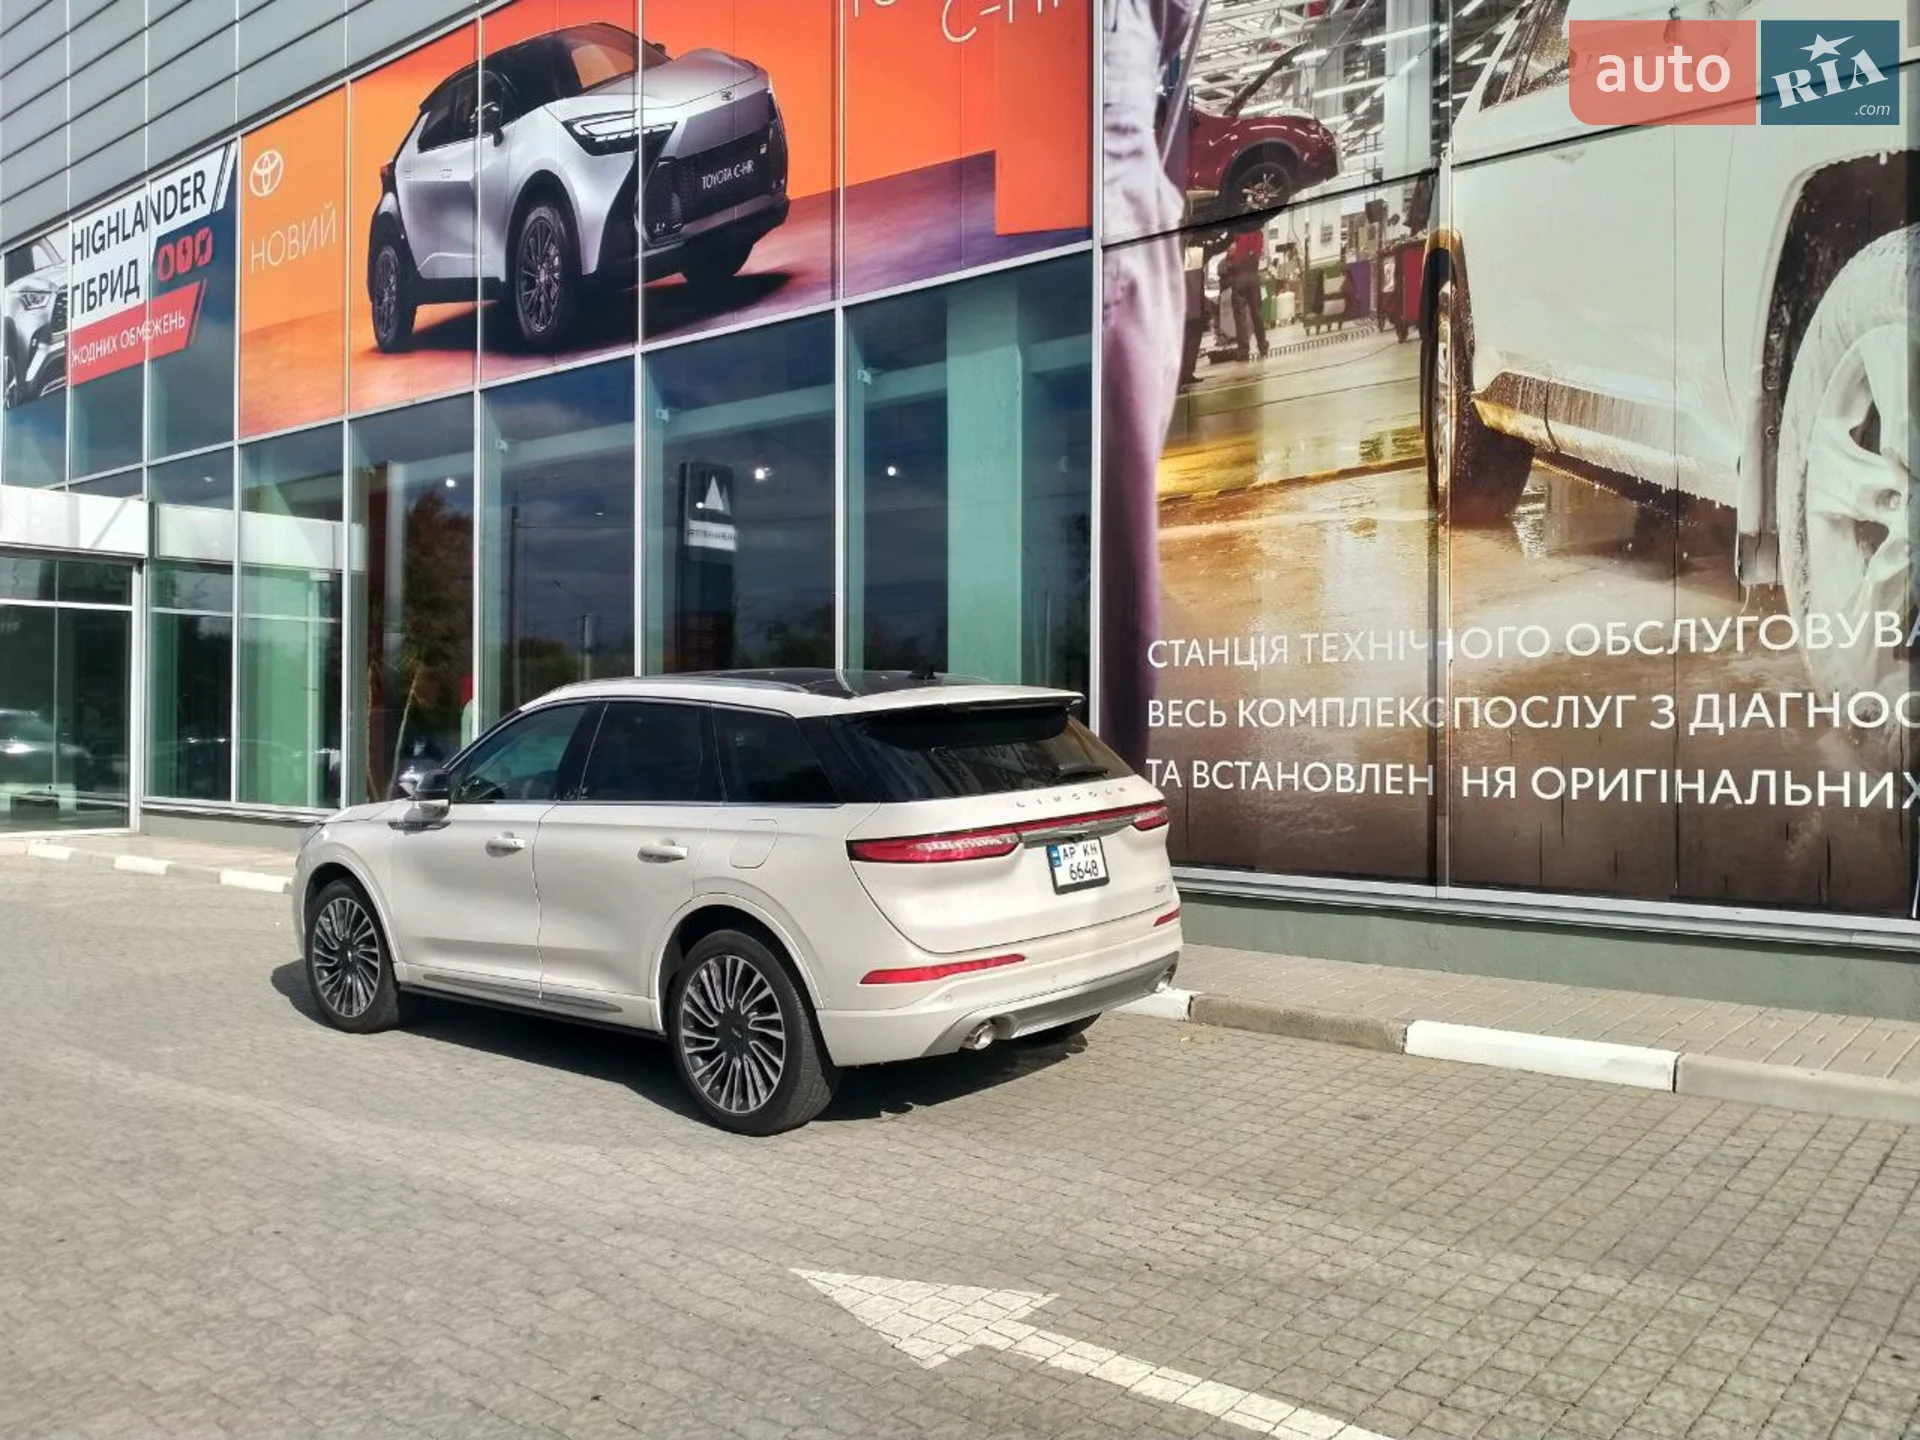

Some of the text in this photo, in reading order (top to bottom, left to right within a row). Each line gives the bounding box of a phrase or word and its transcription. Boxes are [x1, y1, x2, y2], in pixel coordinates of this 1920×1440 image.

[701, 159, 754, 190] TOYOTA C-HR
[72, 170, 207, 265] HIGHLANDER
[251, 201, 336, 275] НОВИЙ
[72, 258, 140, 318] ГІБРИД
[71, 311, 186, 367] ЖОДНИХ ОБМЕЖЕНЬ
[1147, 634, 1288, 671] СТАНЦІЯ
[1301, 625, 1550, 665] ТЕХНІЧНОГО
[1148, 699, 1227, 728] ВЕСЬ
[1238, 697, 1444, 728] КОМПЛЕКС
[1454, 695, 1637, 729] ПОСЛУГ
[1145, 758, 1183, 788] ТА
[1069, 859, 1100, 881] 6648
